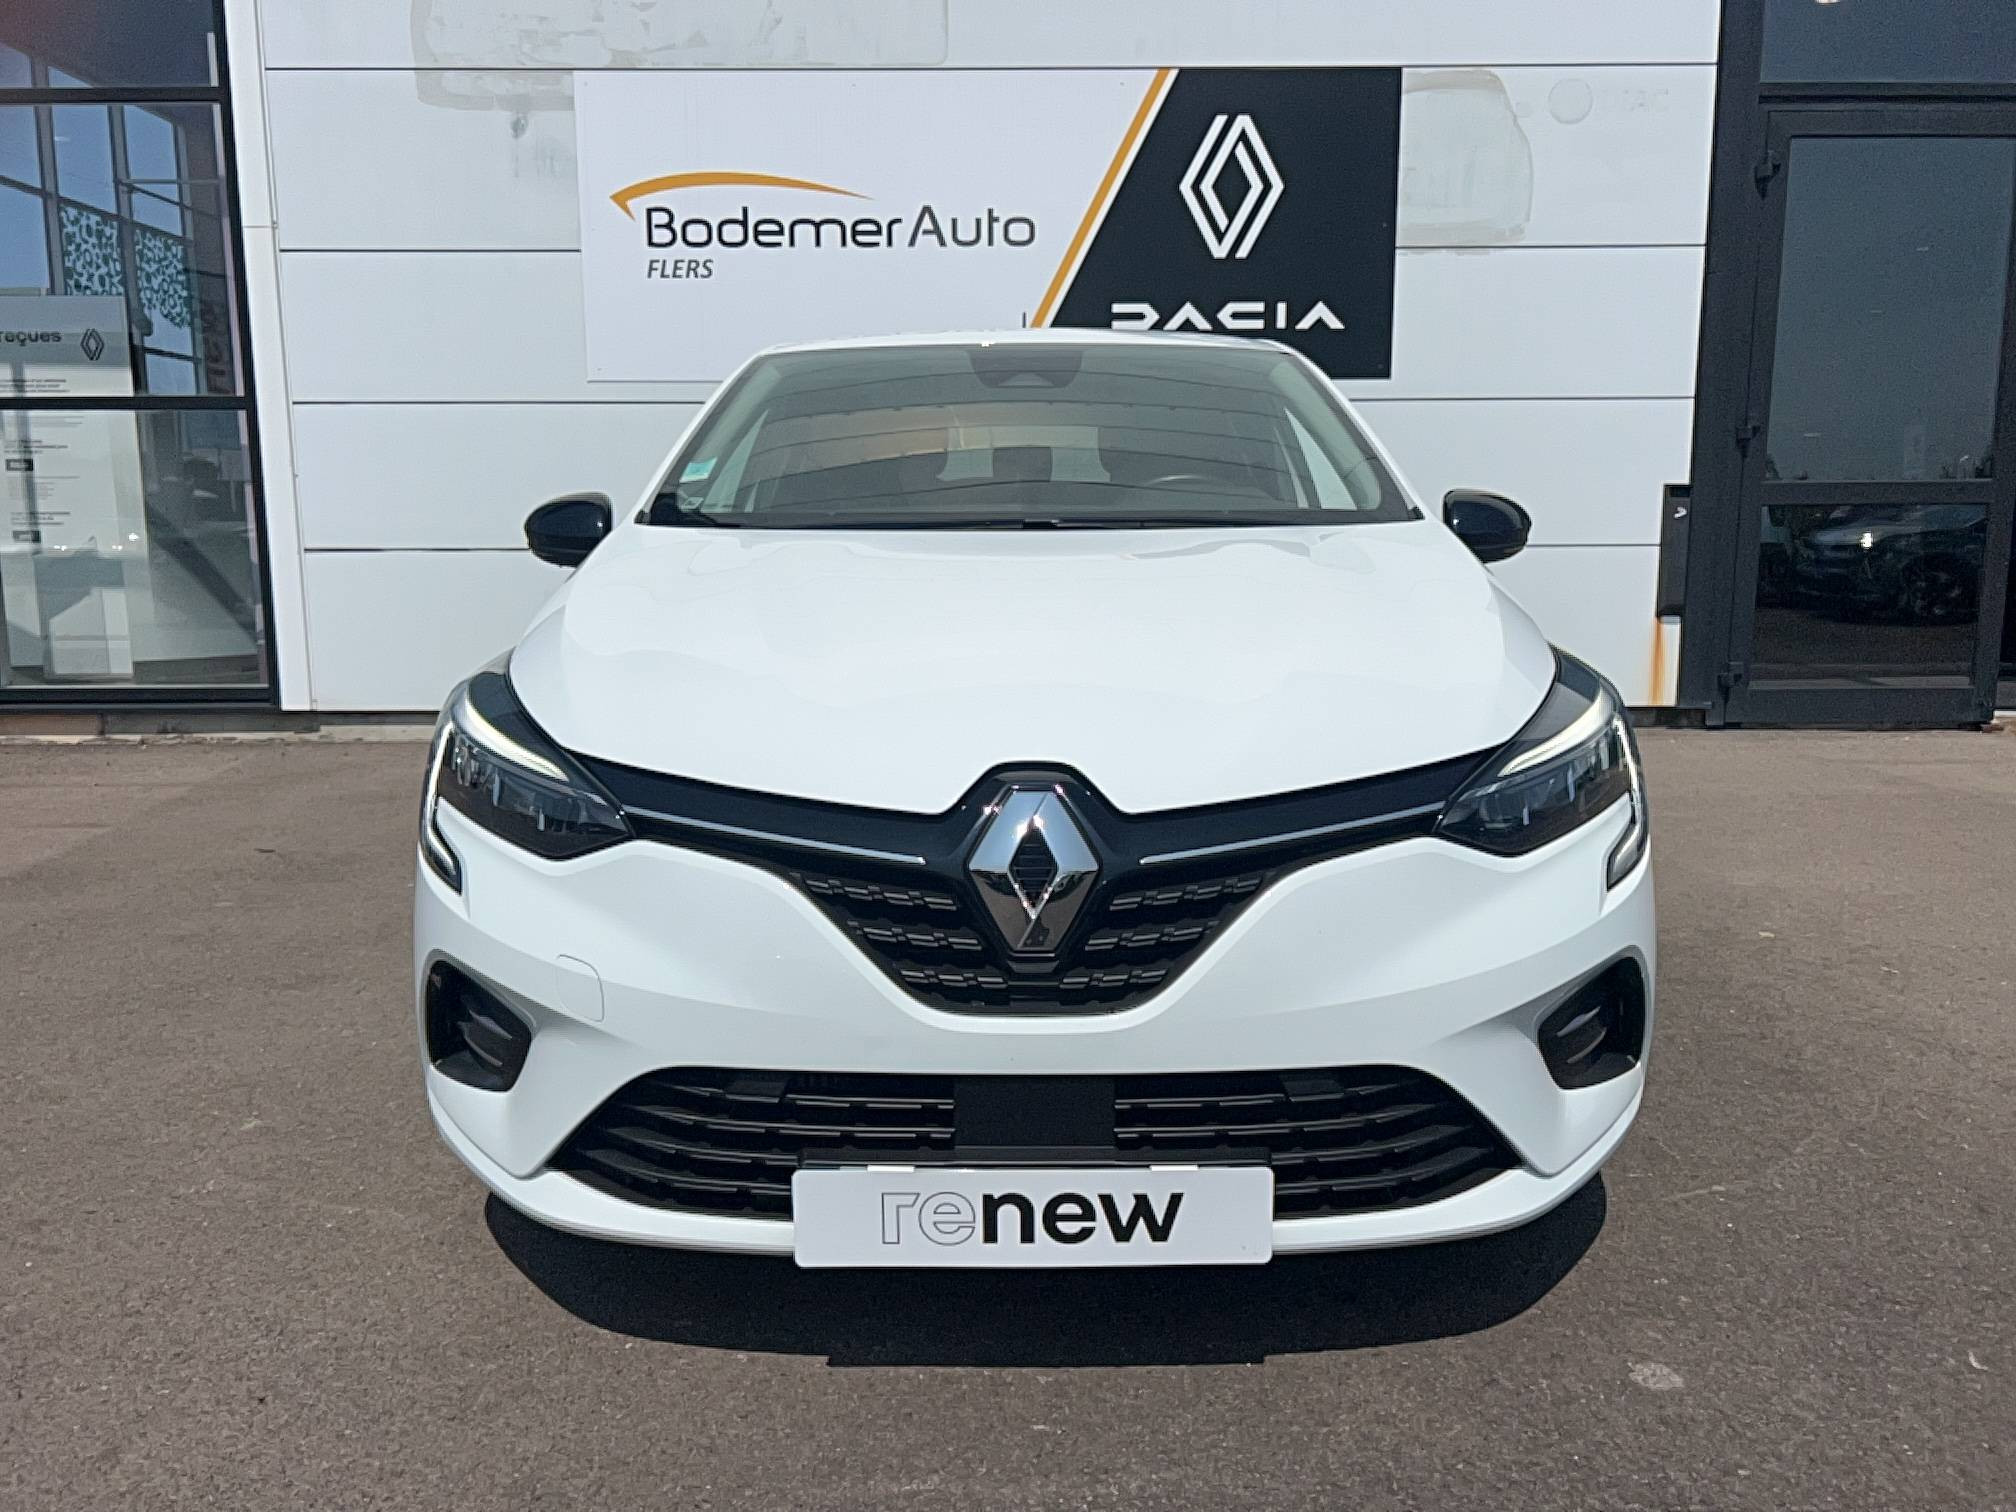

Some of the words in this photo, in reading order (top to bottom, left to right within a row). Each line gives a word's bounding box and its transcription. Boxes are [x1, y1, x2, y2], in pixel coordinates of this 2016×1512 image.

[646, 259, 714, 279] FLERS
[1111, 301, 1346, 331] DACIA
[881, 1191, 1185, 1246] renew
